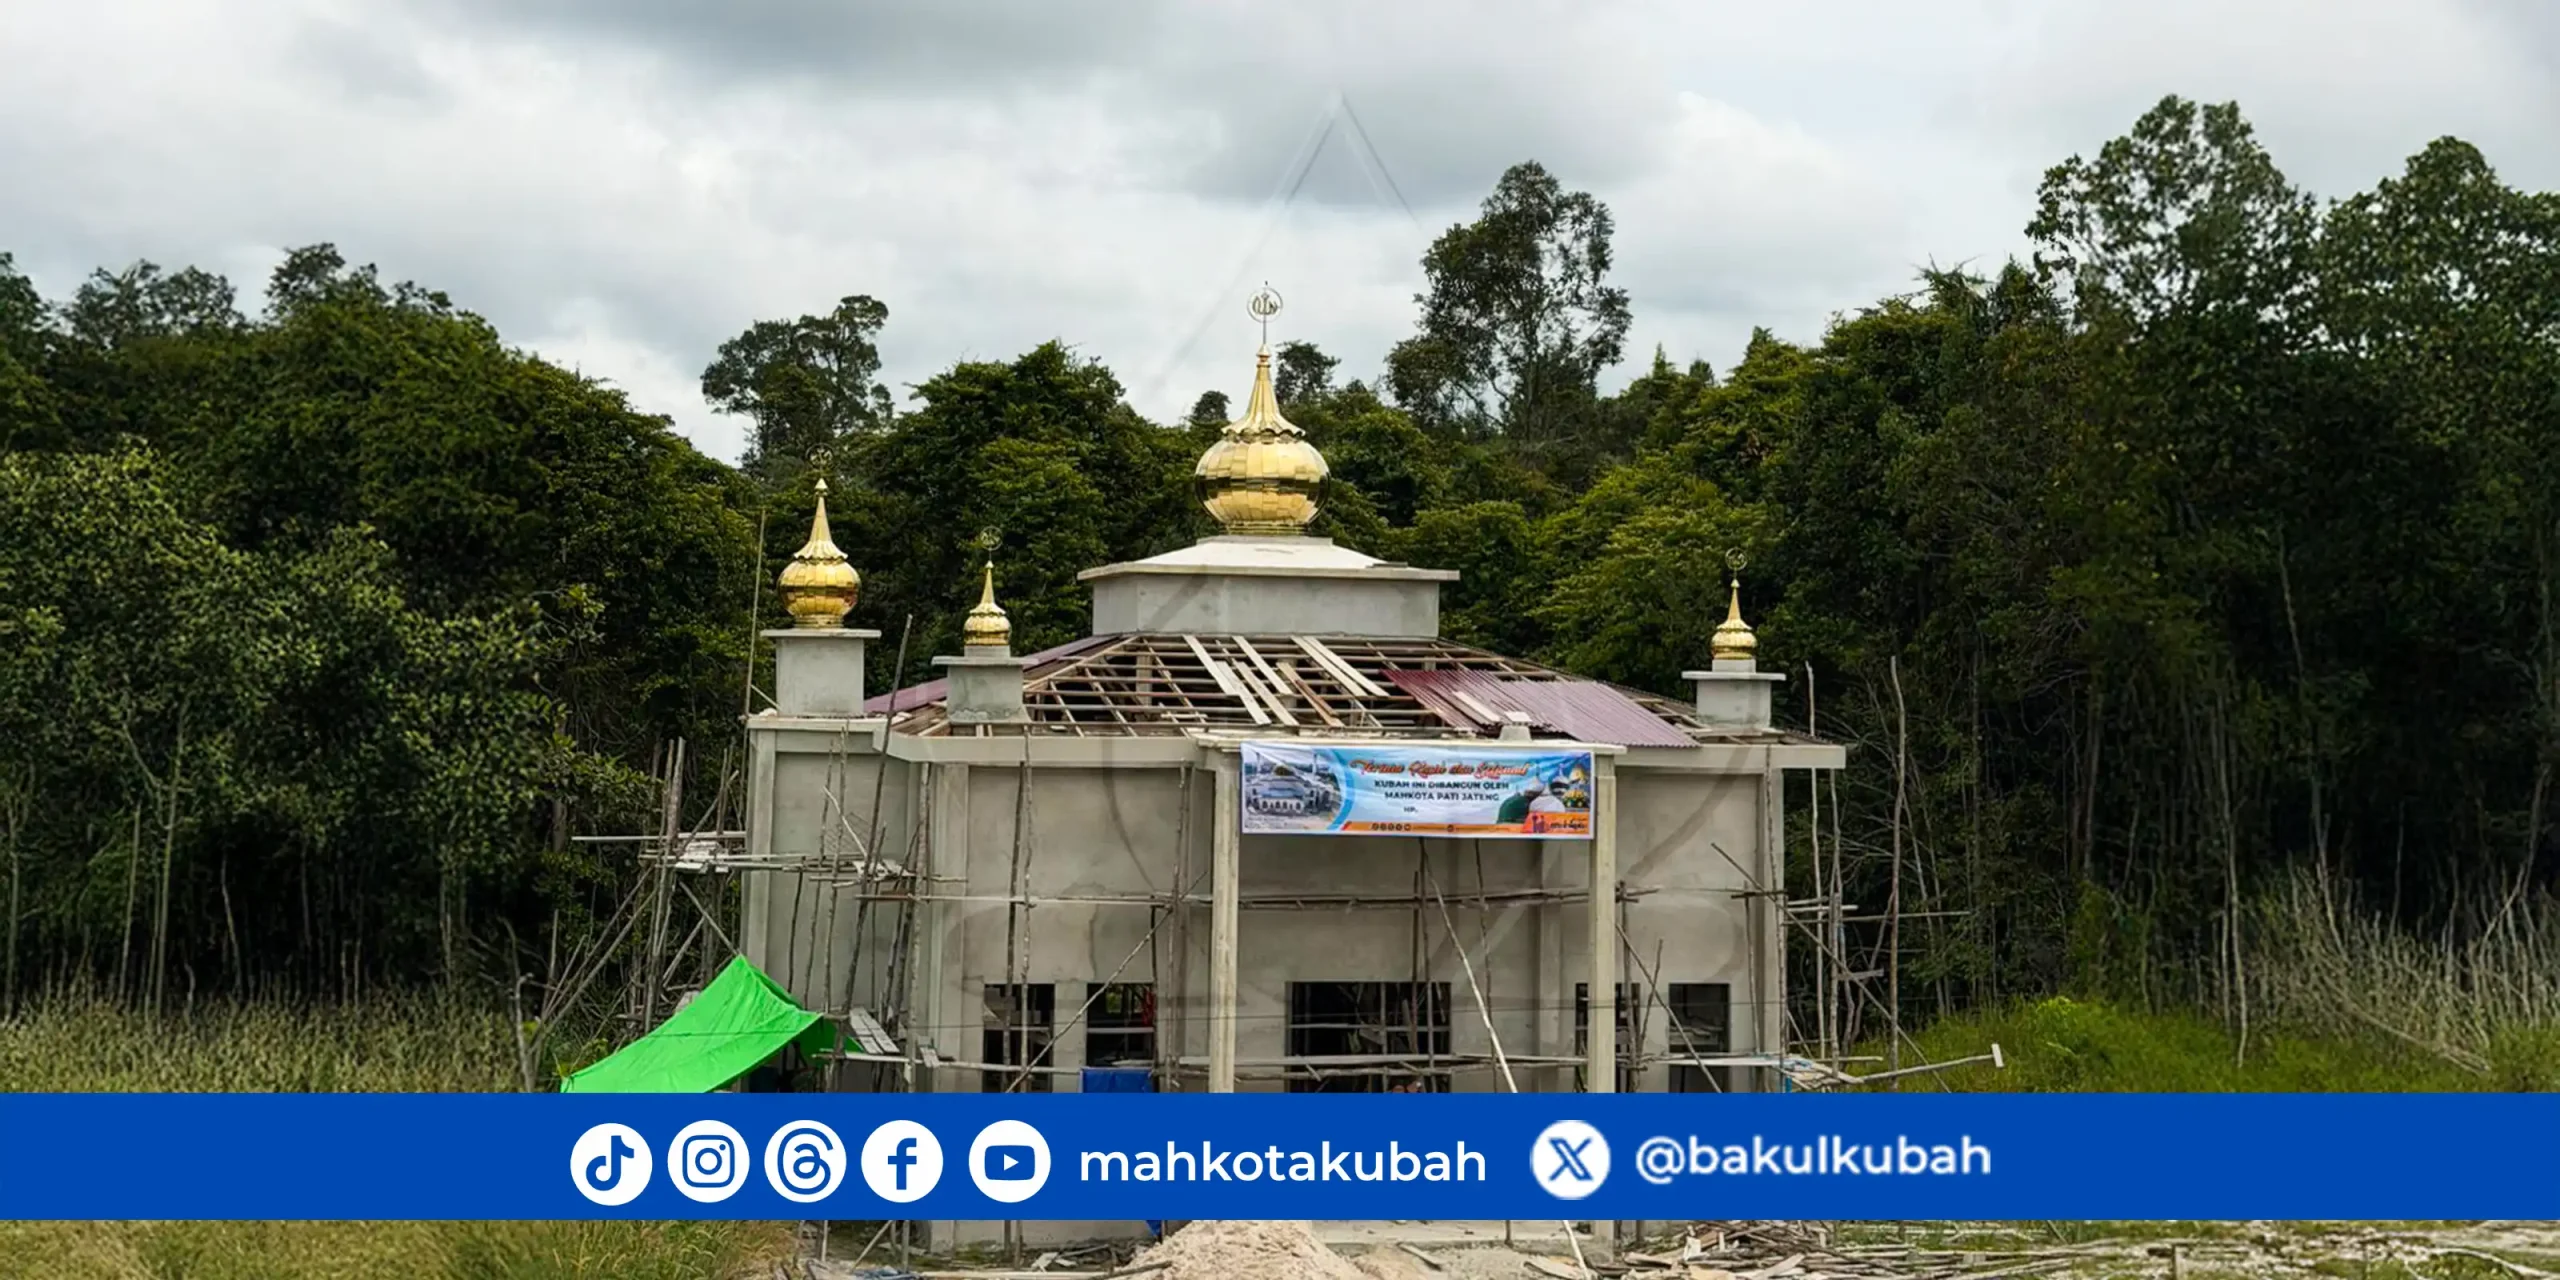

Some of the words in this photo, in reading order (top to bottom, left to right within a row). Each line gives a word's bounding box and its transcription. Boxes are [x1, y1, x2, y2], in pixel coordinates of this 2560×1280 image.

[1375, 780, 1410, 788] KUBAH
[1428, 781, 1480, 789] DIBANGUN
[1483, 782, 1509, 790] OLEH
[1385, 791, 1434, 800] MAHKOTA
[1437, 792, 1459, 800] PATI
[1462, 793, 1500, 801] JATENG
